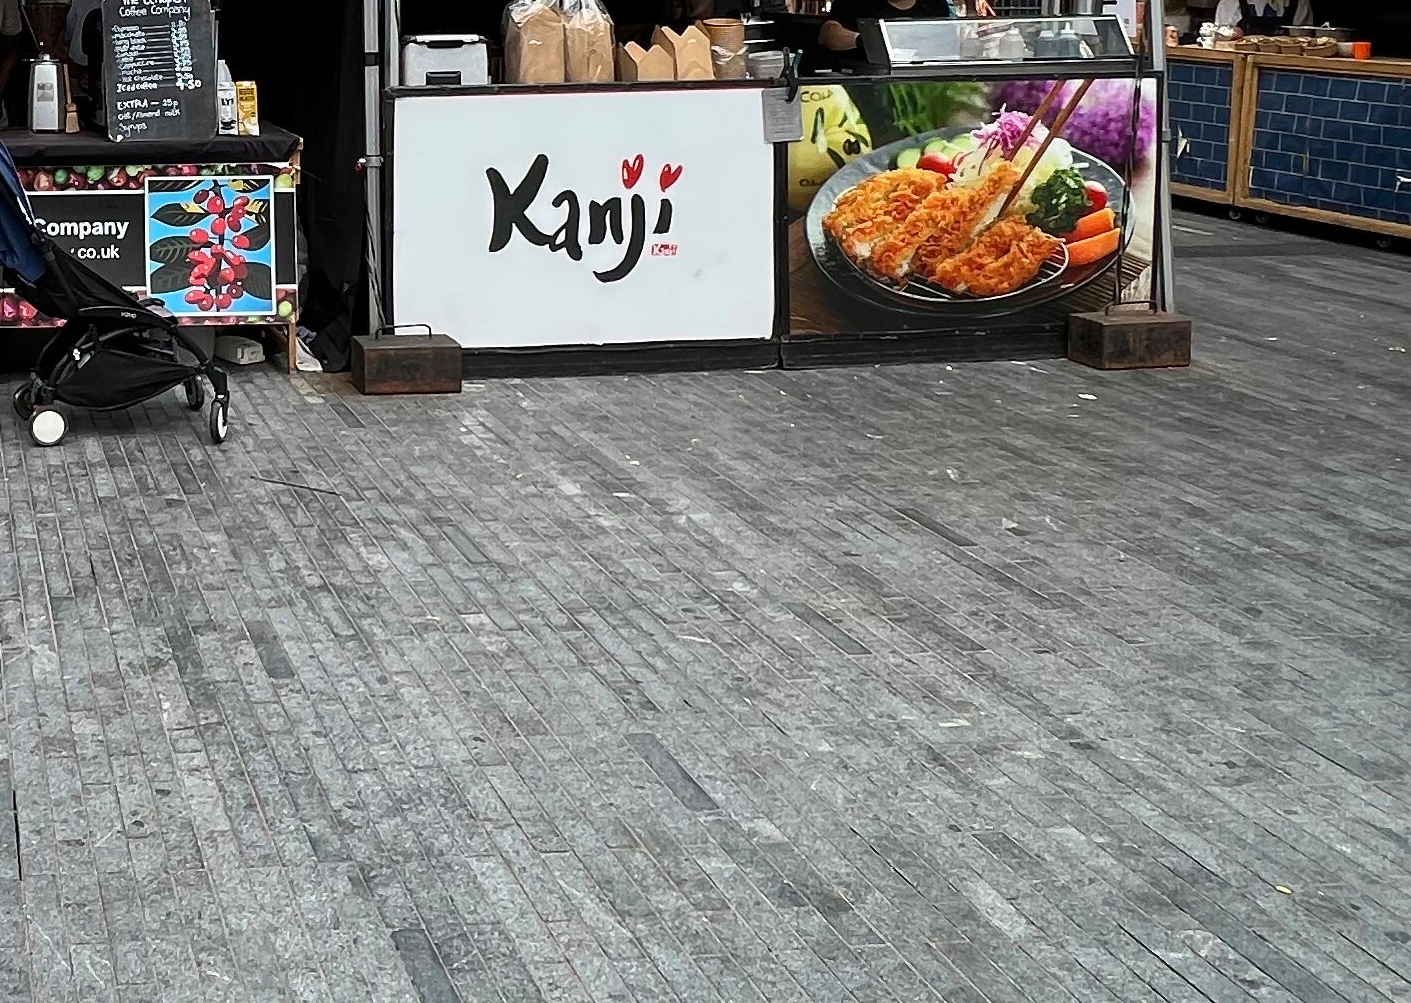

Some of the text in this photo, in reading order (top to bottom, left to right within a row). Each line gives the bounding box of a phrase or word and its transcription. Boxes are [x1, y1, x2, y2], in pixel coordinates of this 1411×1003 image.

[118, 5, 191, 22] Coffee Company
[116, 98, 149, 110] EXTRA
[485, 153, 682, 284] Kanji
